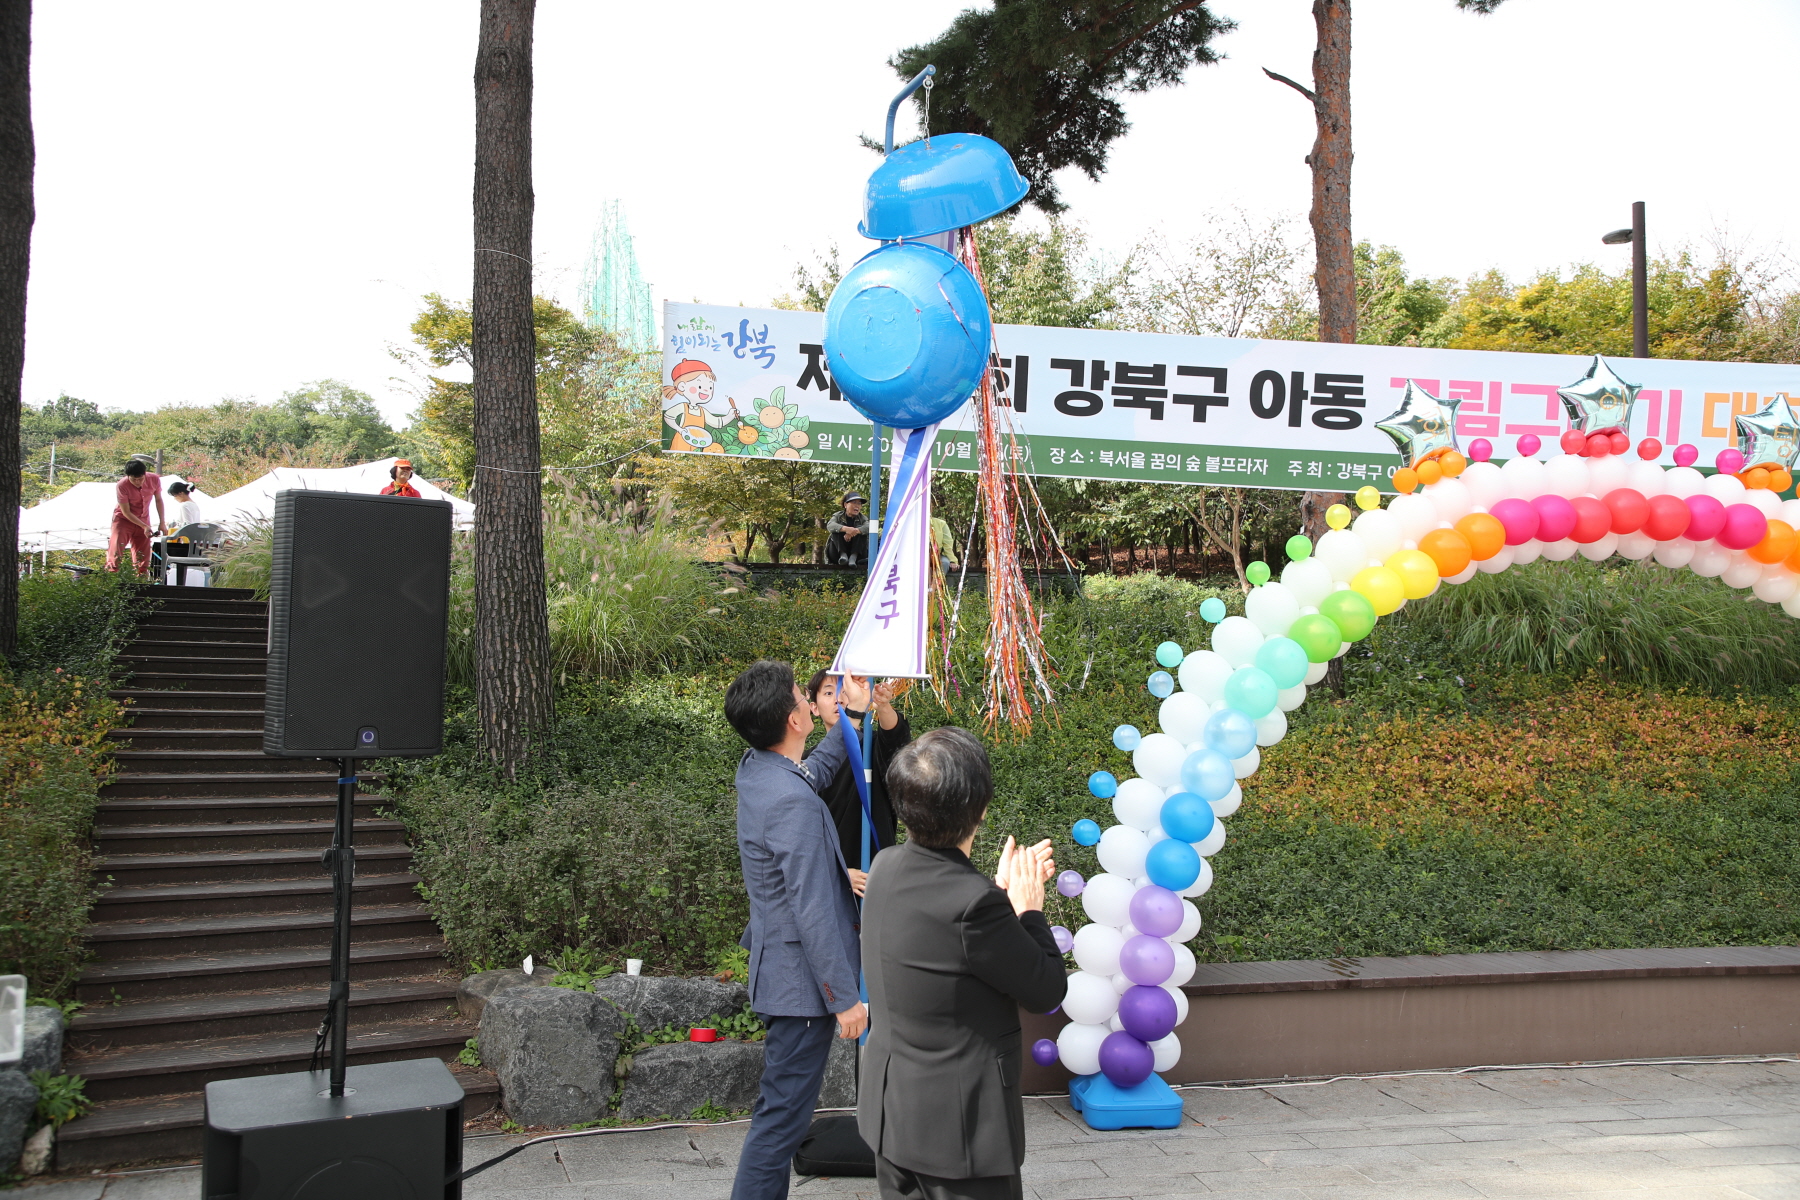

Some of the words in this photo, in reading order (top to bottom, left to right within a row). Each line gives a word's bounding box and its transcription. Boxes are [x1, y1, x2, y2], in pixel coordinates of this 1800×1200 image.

[721, 318, 776, 369] 강북
[1050, 357, 1229, 423] 강북구
[1249, 369, 1367, 431] 아동
[1389, 377, 1683, 447] 림그기
[1701, 392, 1800, 448] 대
[935, 441, 972, 459] 10월
[1099, 450, 1146, 469] 북서울
[1150, 453, 1181, 471] 꿈의
[1185, 455, 1201, 472] 숲
[1205, 456, 1269, 475] 볼프라자
[1336, 463, 1382, 481] 강북구
[875, 553, 901, 630] 북구
